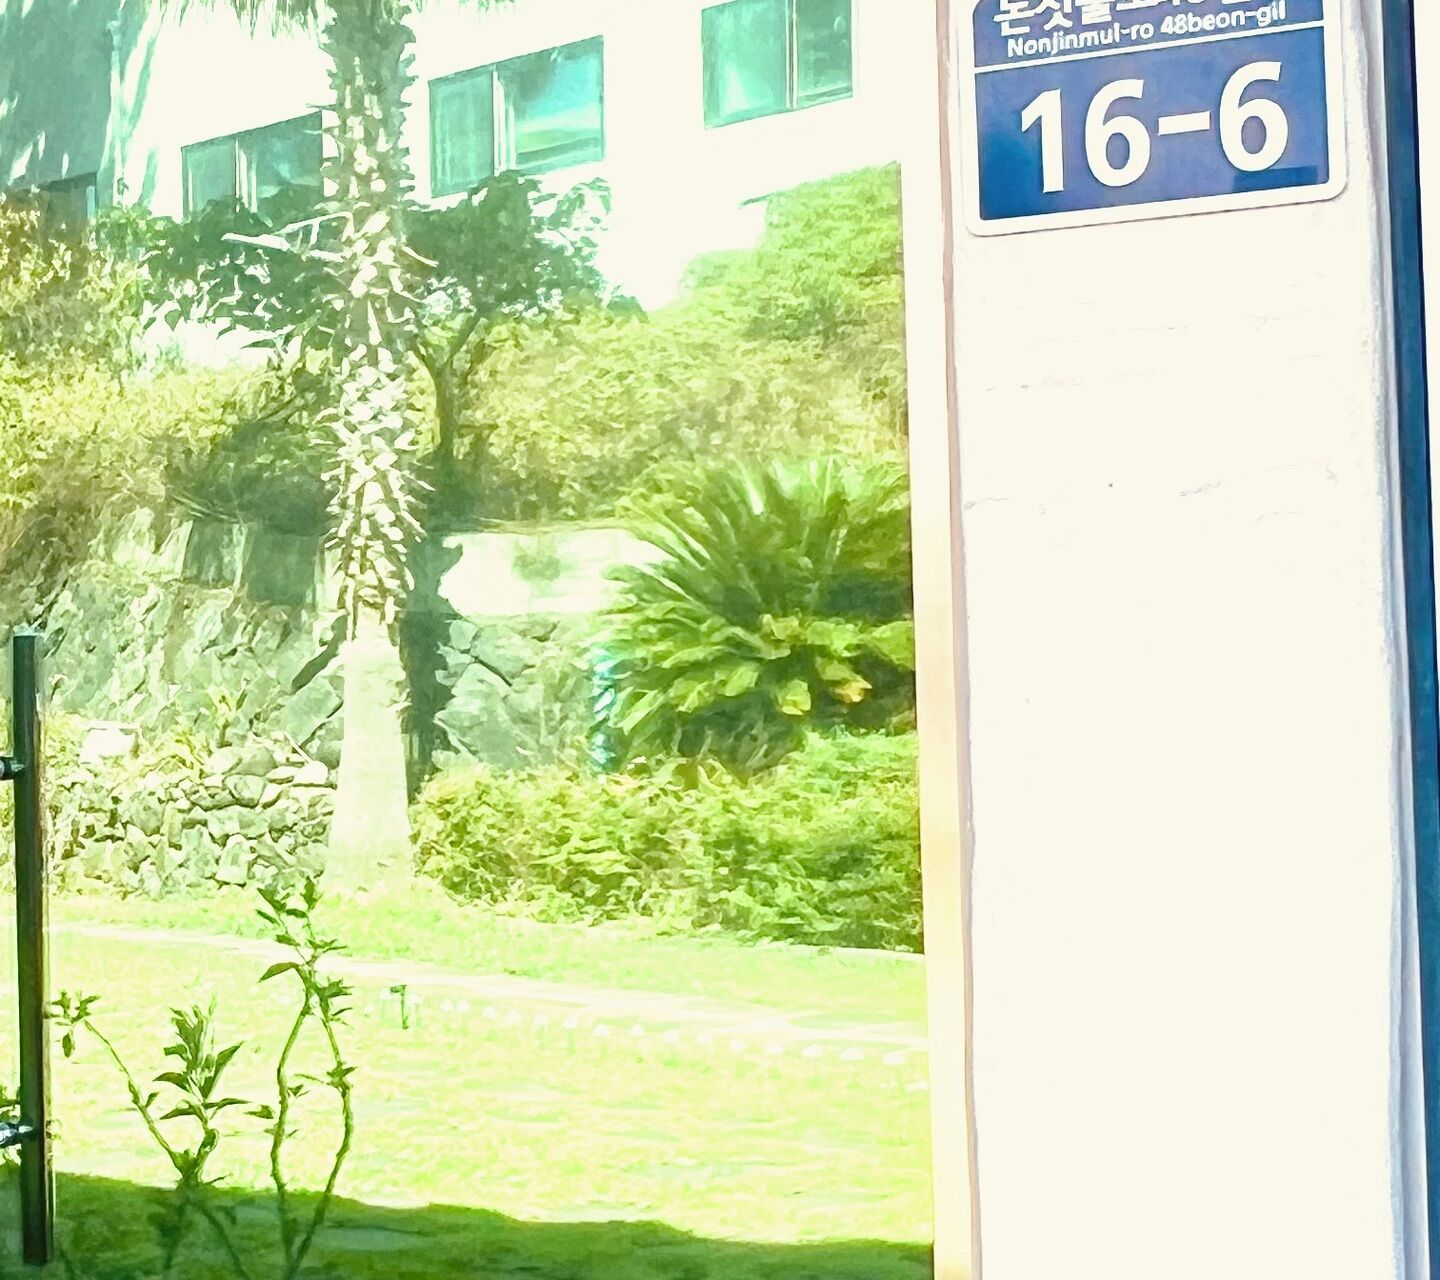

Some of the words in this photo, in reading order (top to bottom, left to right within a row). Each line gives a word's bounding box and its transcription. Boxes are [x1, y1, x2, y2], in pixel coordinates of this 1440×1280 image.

[1007, 23, 1155, 58] Nonjinmul-ro
[1160, 0, 1287, 36] 48beon-gil
[1021, 61, 1289, 194] 16-6
